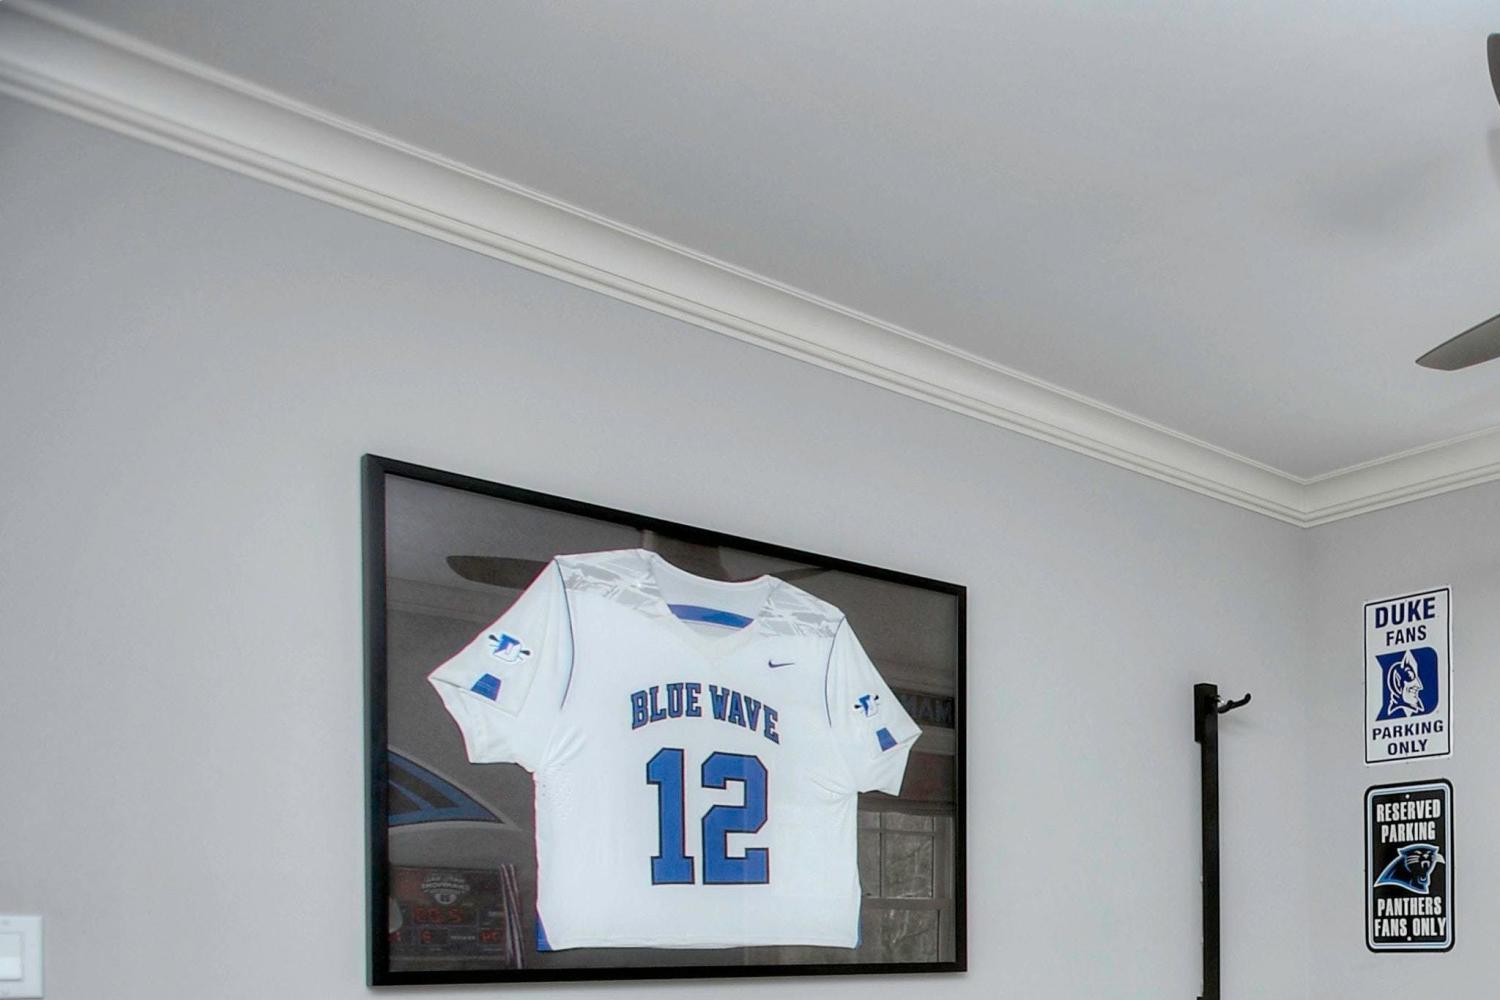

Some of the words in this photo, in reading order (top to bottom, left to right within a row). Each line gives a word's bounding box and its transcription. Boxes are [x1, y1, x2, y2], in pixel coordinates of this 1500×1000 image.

[1374, 596, 1436, 629] DUKE
[1386, 624, 1427, 647] FANS
[630, 682, 703, 730] BLUE
[708, 684, 781, 745] WAVE
[1372, 719, 1444, 741] PARKING
[1387, 738, 1428, 756] ONLY
[646, 747, 770, 885] 12
[1376, 799, 1442, 823] RESERVED
[1381, 821, 1437, 844] PARKING
[1377, 896, 1443, 918] PANTHERS
[1374, 918, 1409, 938] FANS
[1412, 916, 1448, 937] ONLY
